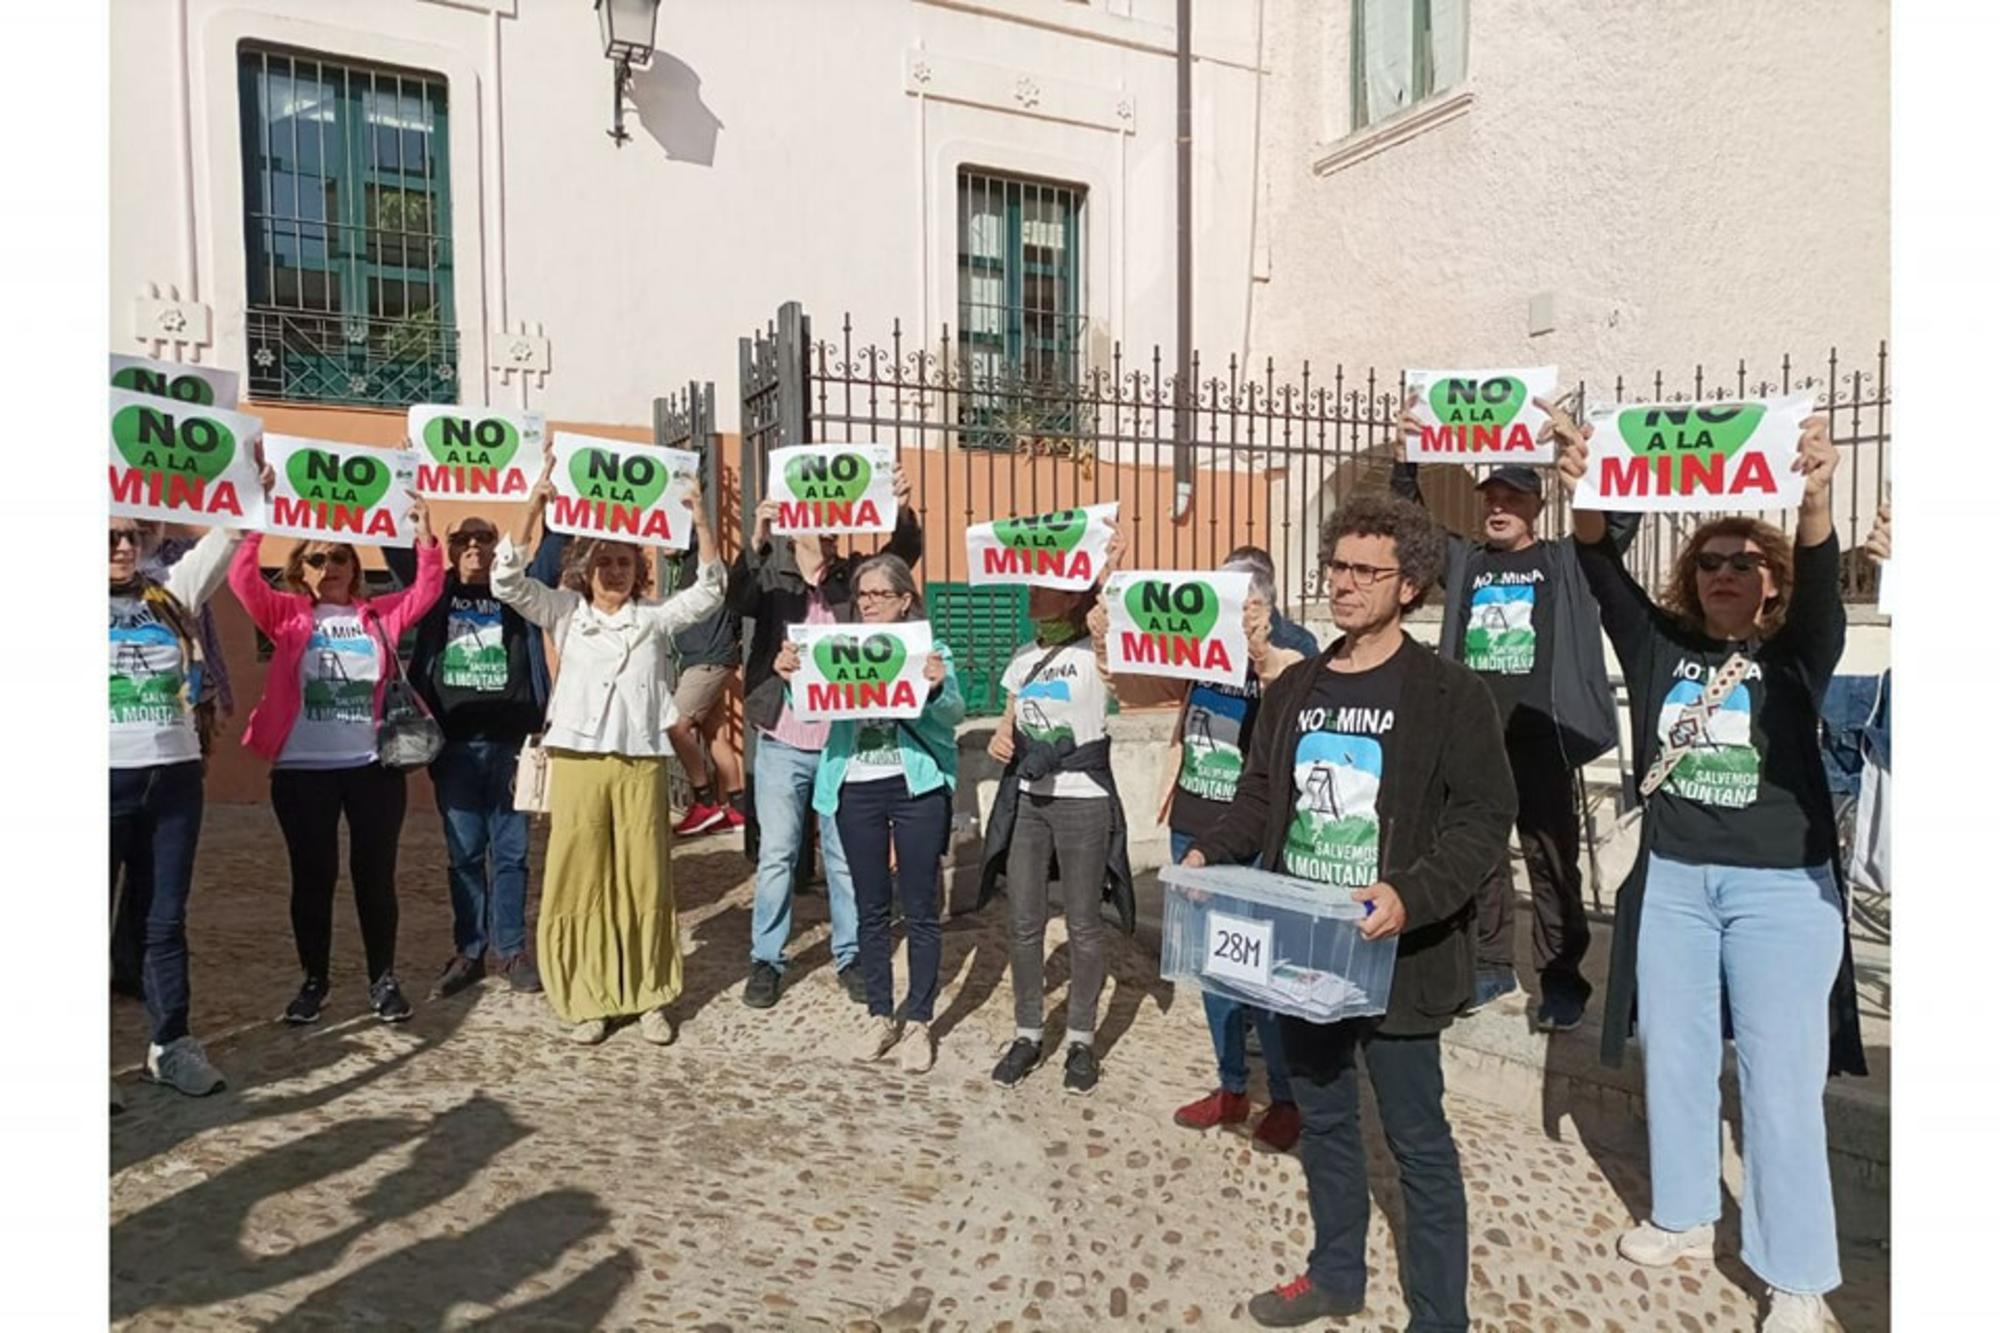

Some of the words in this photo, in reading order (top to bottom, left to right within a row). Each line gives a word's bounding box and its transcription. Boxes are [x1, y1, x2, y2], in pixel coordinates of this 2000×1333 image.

[134, 368, 201, 401] NO
[1447, 377, 1512, 406] NO
[1450, 410, 1463, 422] A
[1470, 409, 1494, 422] LA
[138, 409, 219, 453] NO
[442, 417, 505, 448] NO
[1420, 424, 1535, 452] MINA
[1647, 432, 1667, 451] A
[1677, 430, 1714, 450] LA
[140, 451, 158, 467] A
[168, 453, 198, 472] LA
[307, 451, 376, 486] NO
[447, 451, 460, 463] A
[466, 451, 490, 464] LA
[588, 451, 655, 486] NO
[801, 454, 858, 482] NO
[416, 465, 528, 494] MINA
[1599, 451, 1777, 497] MINA
[109, 464, 243, 517] MINA
[310, 485, 324, 498] A
[332, 487, 358, 502] LA
[589, 486, 601, 498] A
[609, 487, 635, 502] LA
[805, 486, 818, 499] A
[823, 485, 845, 498] LA
[273, 496, 397, 538] MINA
[554, 495, 671, 540] MINA
[778, 499, 882, 529] MINA
[1014, 534, 1027, 547] A
[1033, 534, 1058, 547] LA
[984, 547, 1092, 581] MINA
[1502, 568, 1544, 585] MINA
[1142, 581, 1205, 615] NO
[1150, 617, 1162, 630] A
[1168, 618, 1192, 632] LA
[831, 633, 893, 665] NO
[1121, 631, 1232, 672] MINA
[837, 668, 850, 680] A
[856, 667, 880, 680] LA
[807, 680, 917, 711] MINA
[1297, 707, 1326, 732] NO
[1337, 706, 1395, 734] MINA
[1315, 841, 1378, 862] SALVEMOS
[1214, 930, 1261, 968] 28M
